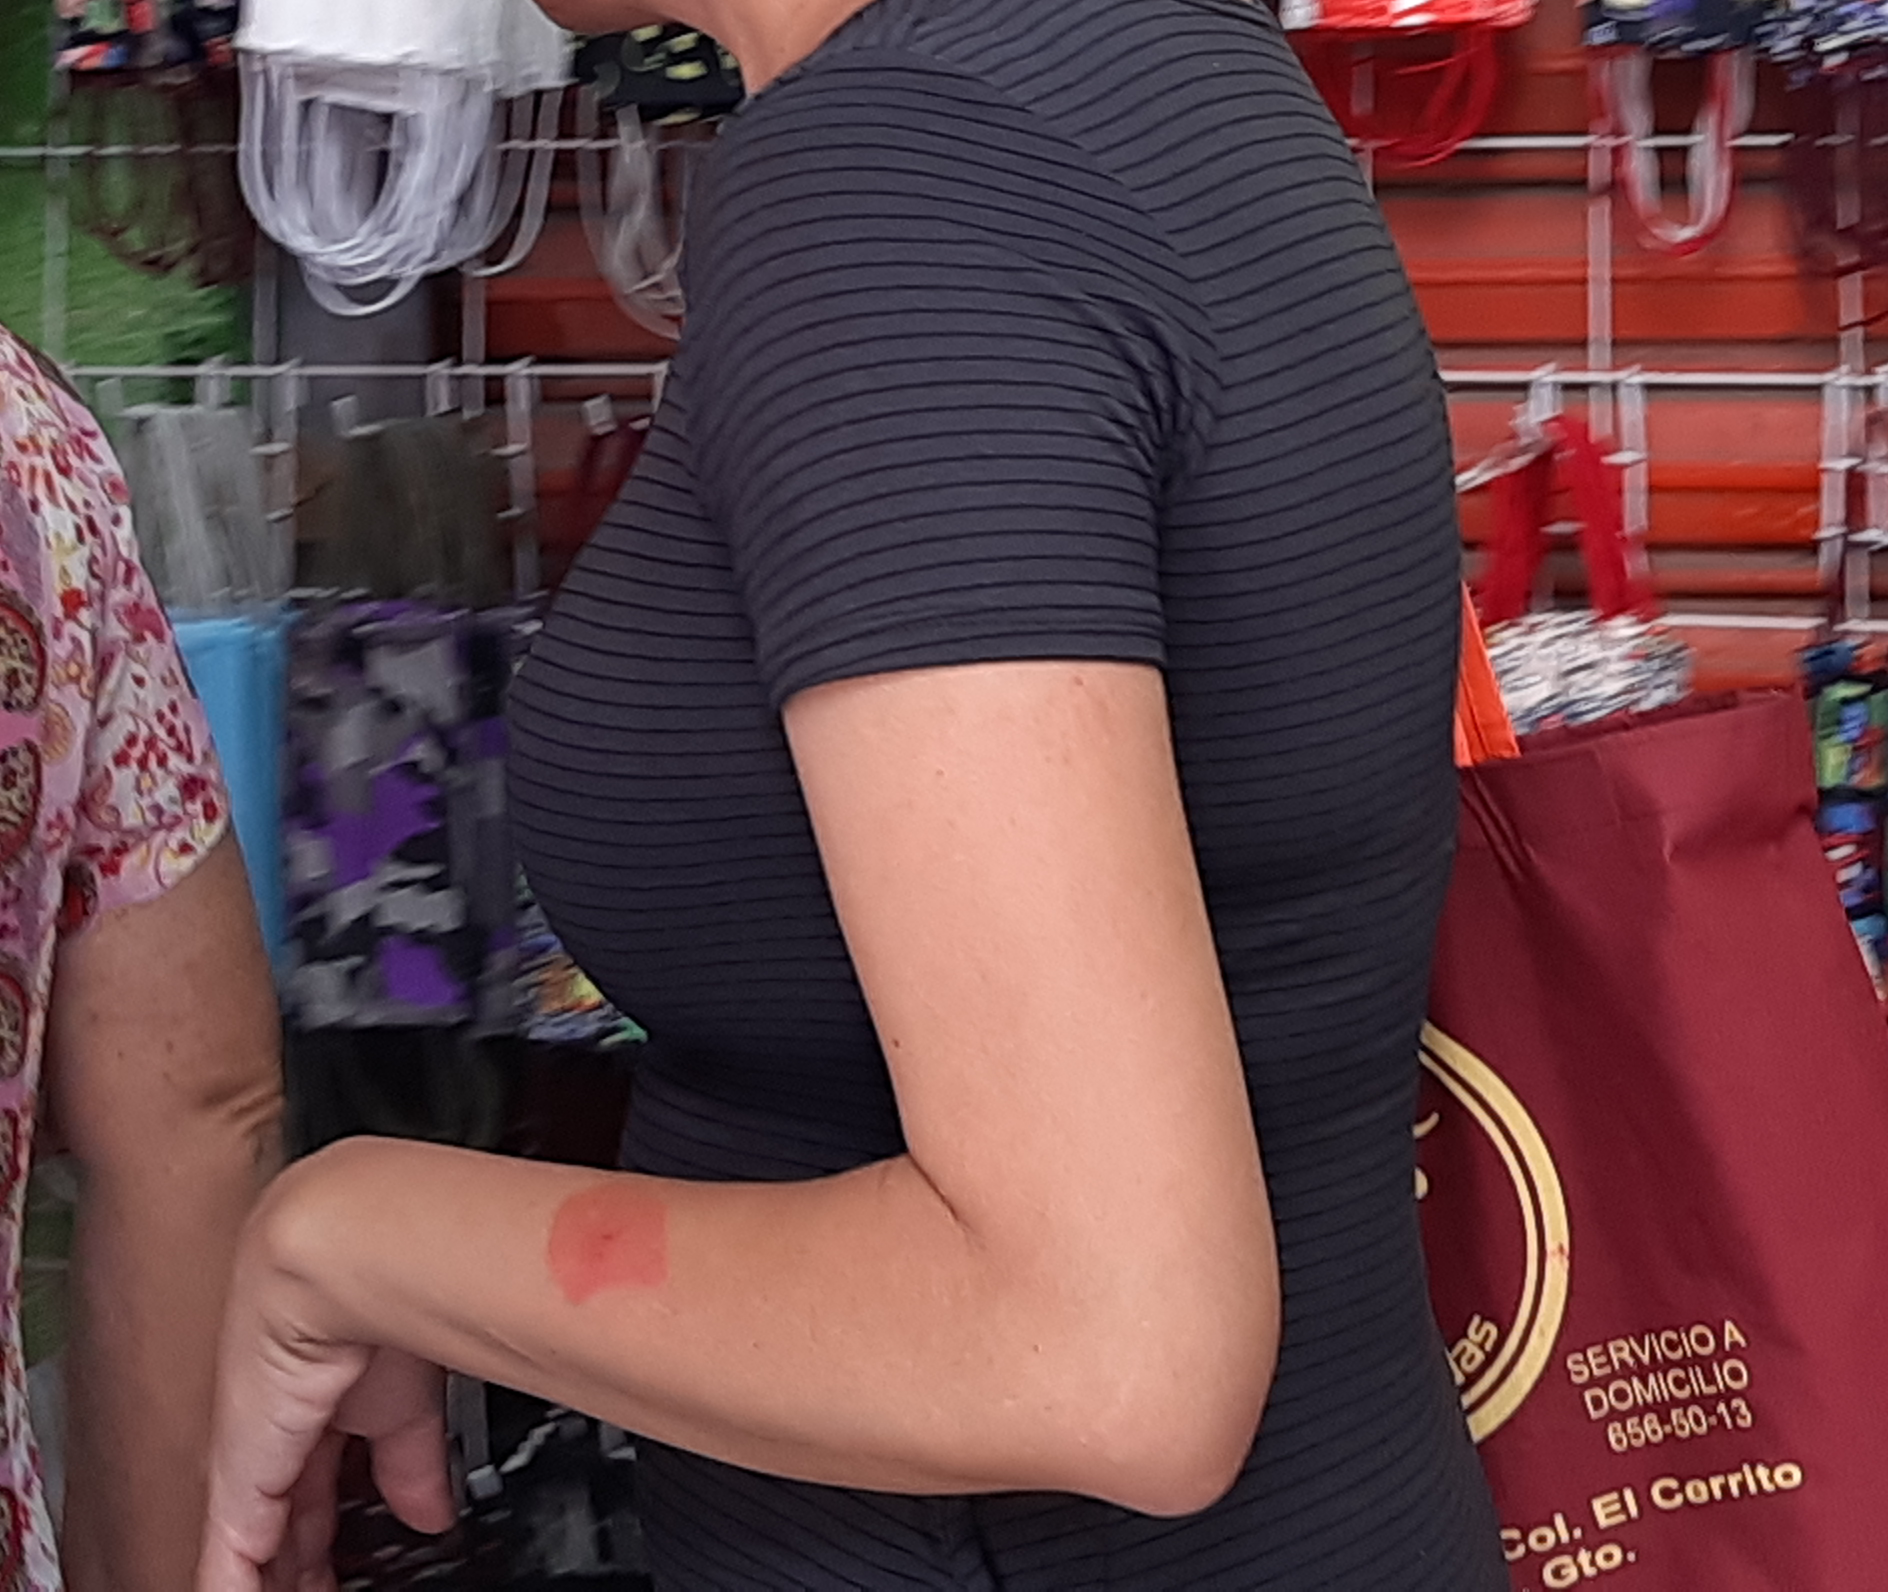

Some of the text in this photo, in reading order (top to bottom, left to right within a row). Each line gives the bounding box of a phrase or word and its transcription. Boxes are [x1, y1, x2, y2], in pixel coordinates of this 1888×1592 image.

[1723, 1319, 1748, 1352] A
[1583, 1358, 1749, 1421] DOMICILIO
[1607, 1397, 1753, 1453] 656-50-13
[1591, 1486, 1639, 1529] El
[1542, 1543, 1638, 1590] Gto.
